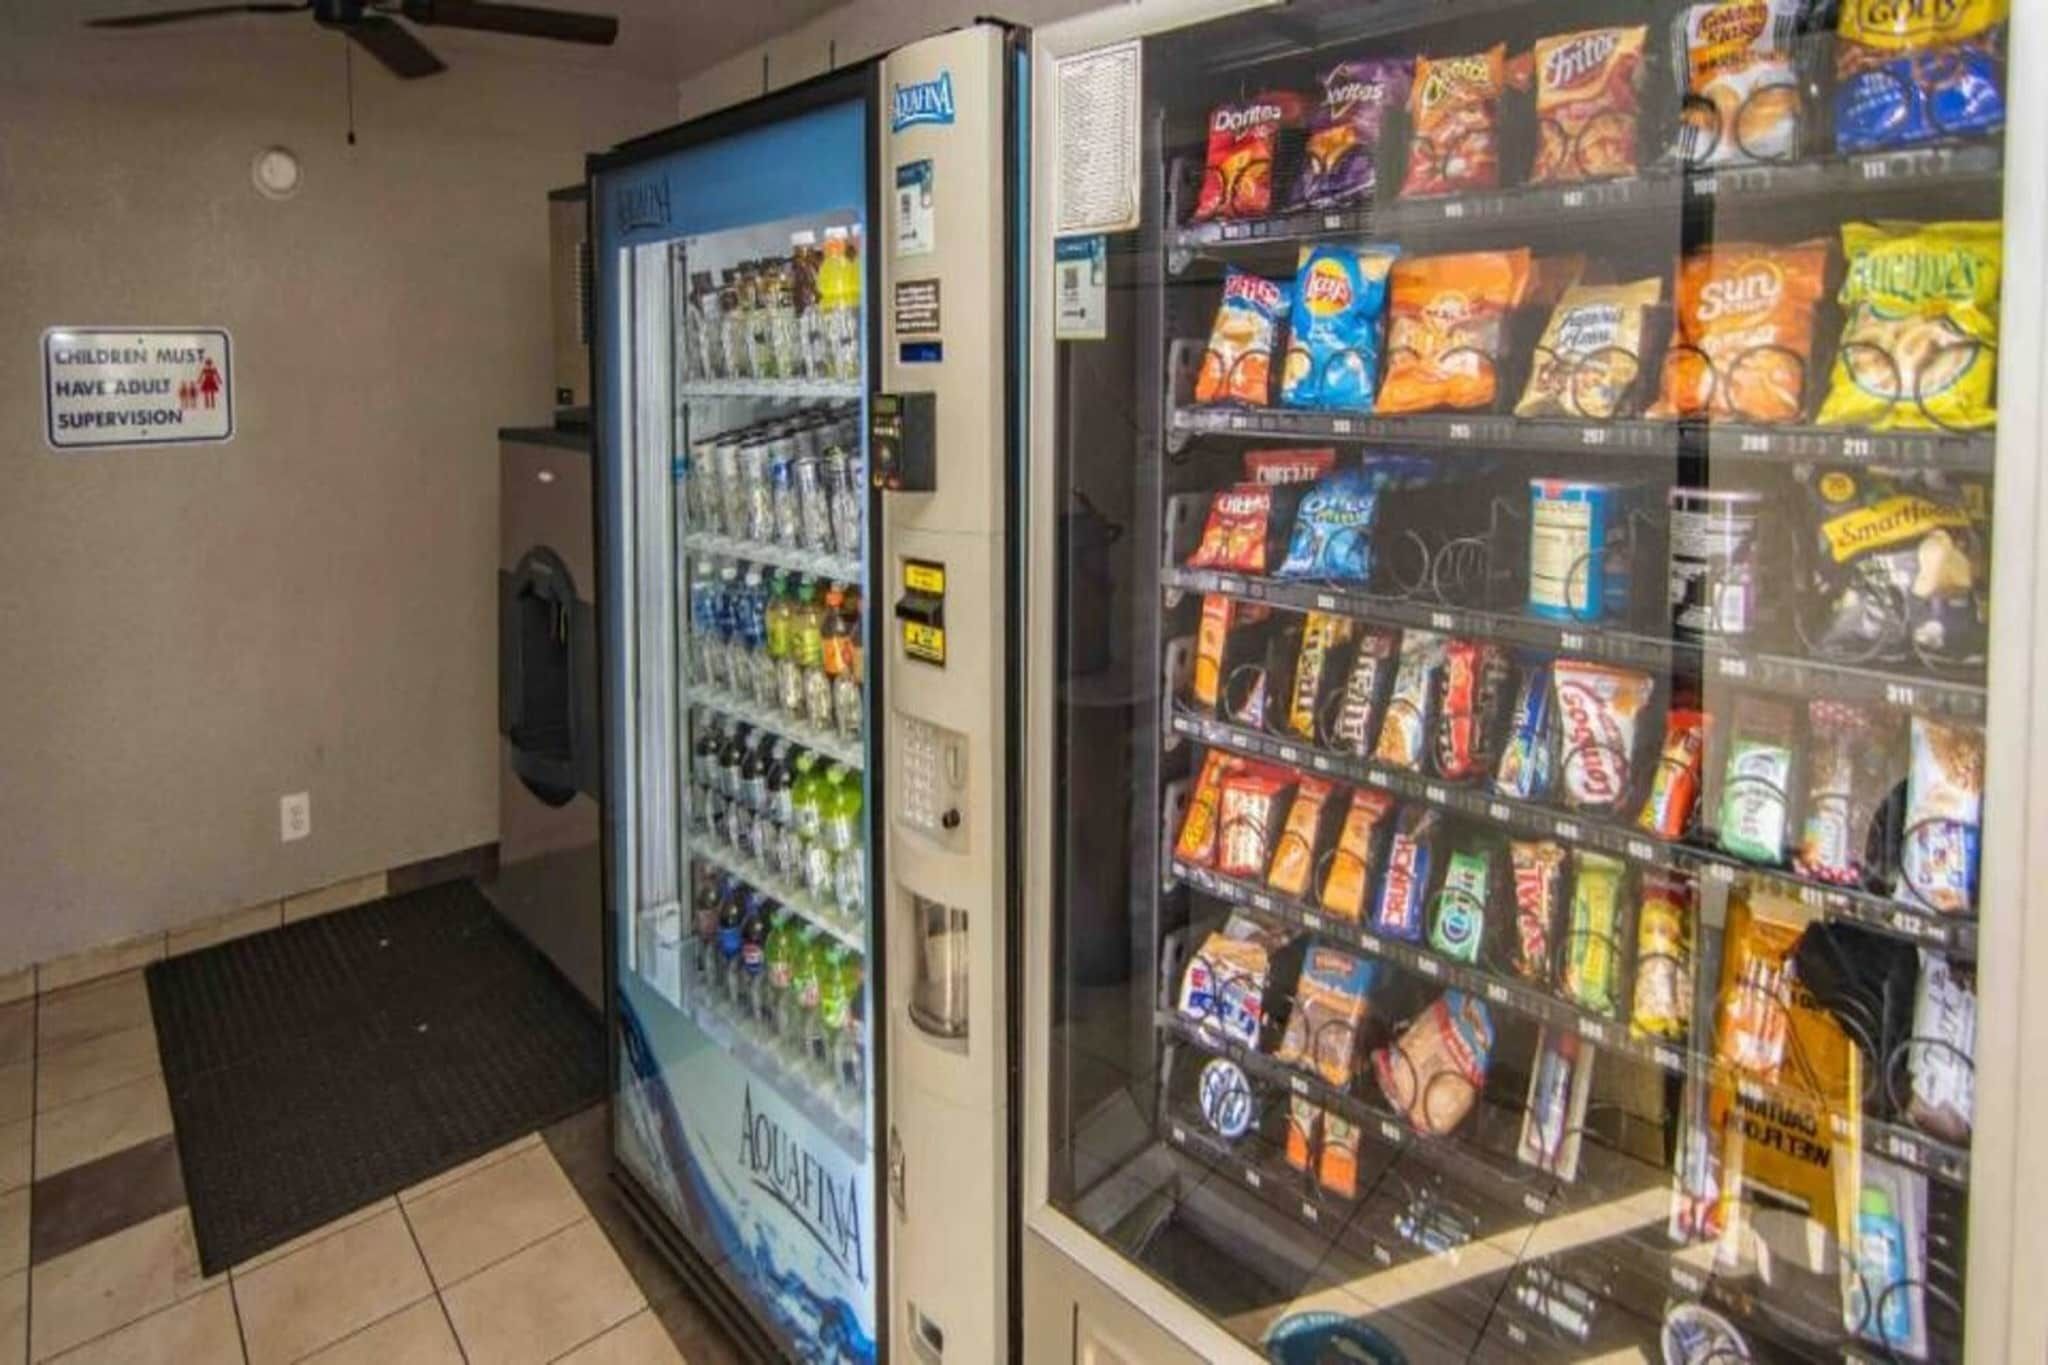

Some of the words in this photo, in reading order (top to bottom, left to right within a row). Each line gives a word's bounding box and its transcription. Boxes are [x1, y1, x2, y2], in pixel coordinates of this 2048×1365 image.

[1548, 35, 1619, 85] Fritos
[1215, 104, 1281, 132] Doritos
[1696, 272, 1782, 320] Sun
[55, 350, 147, 365] CHILDREN
[156, 349, 205, 364] MUST
[56, 380, 106, 397] HAVE
[114, 379, 170, 395] ADULT
[58, 411, 183, 429] SUPERVISION
[738, 1080, 867, 1290] AQUAFINA
